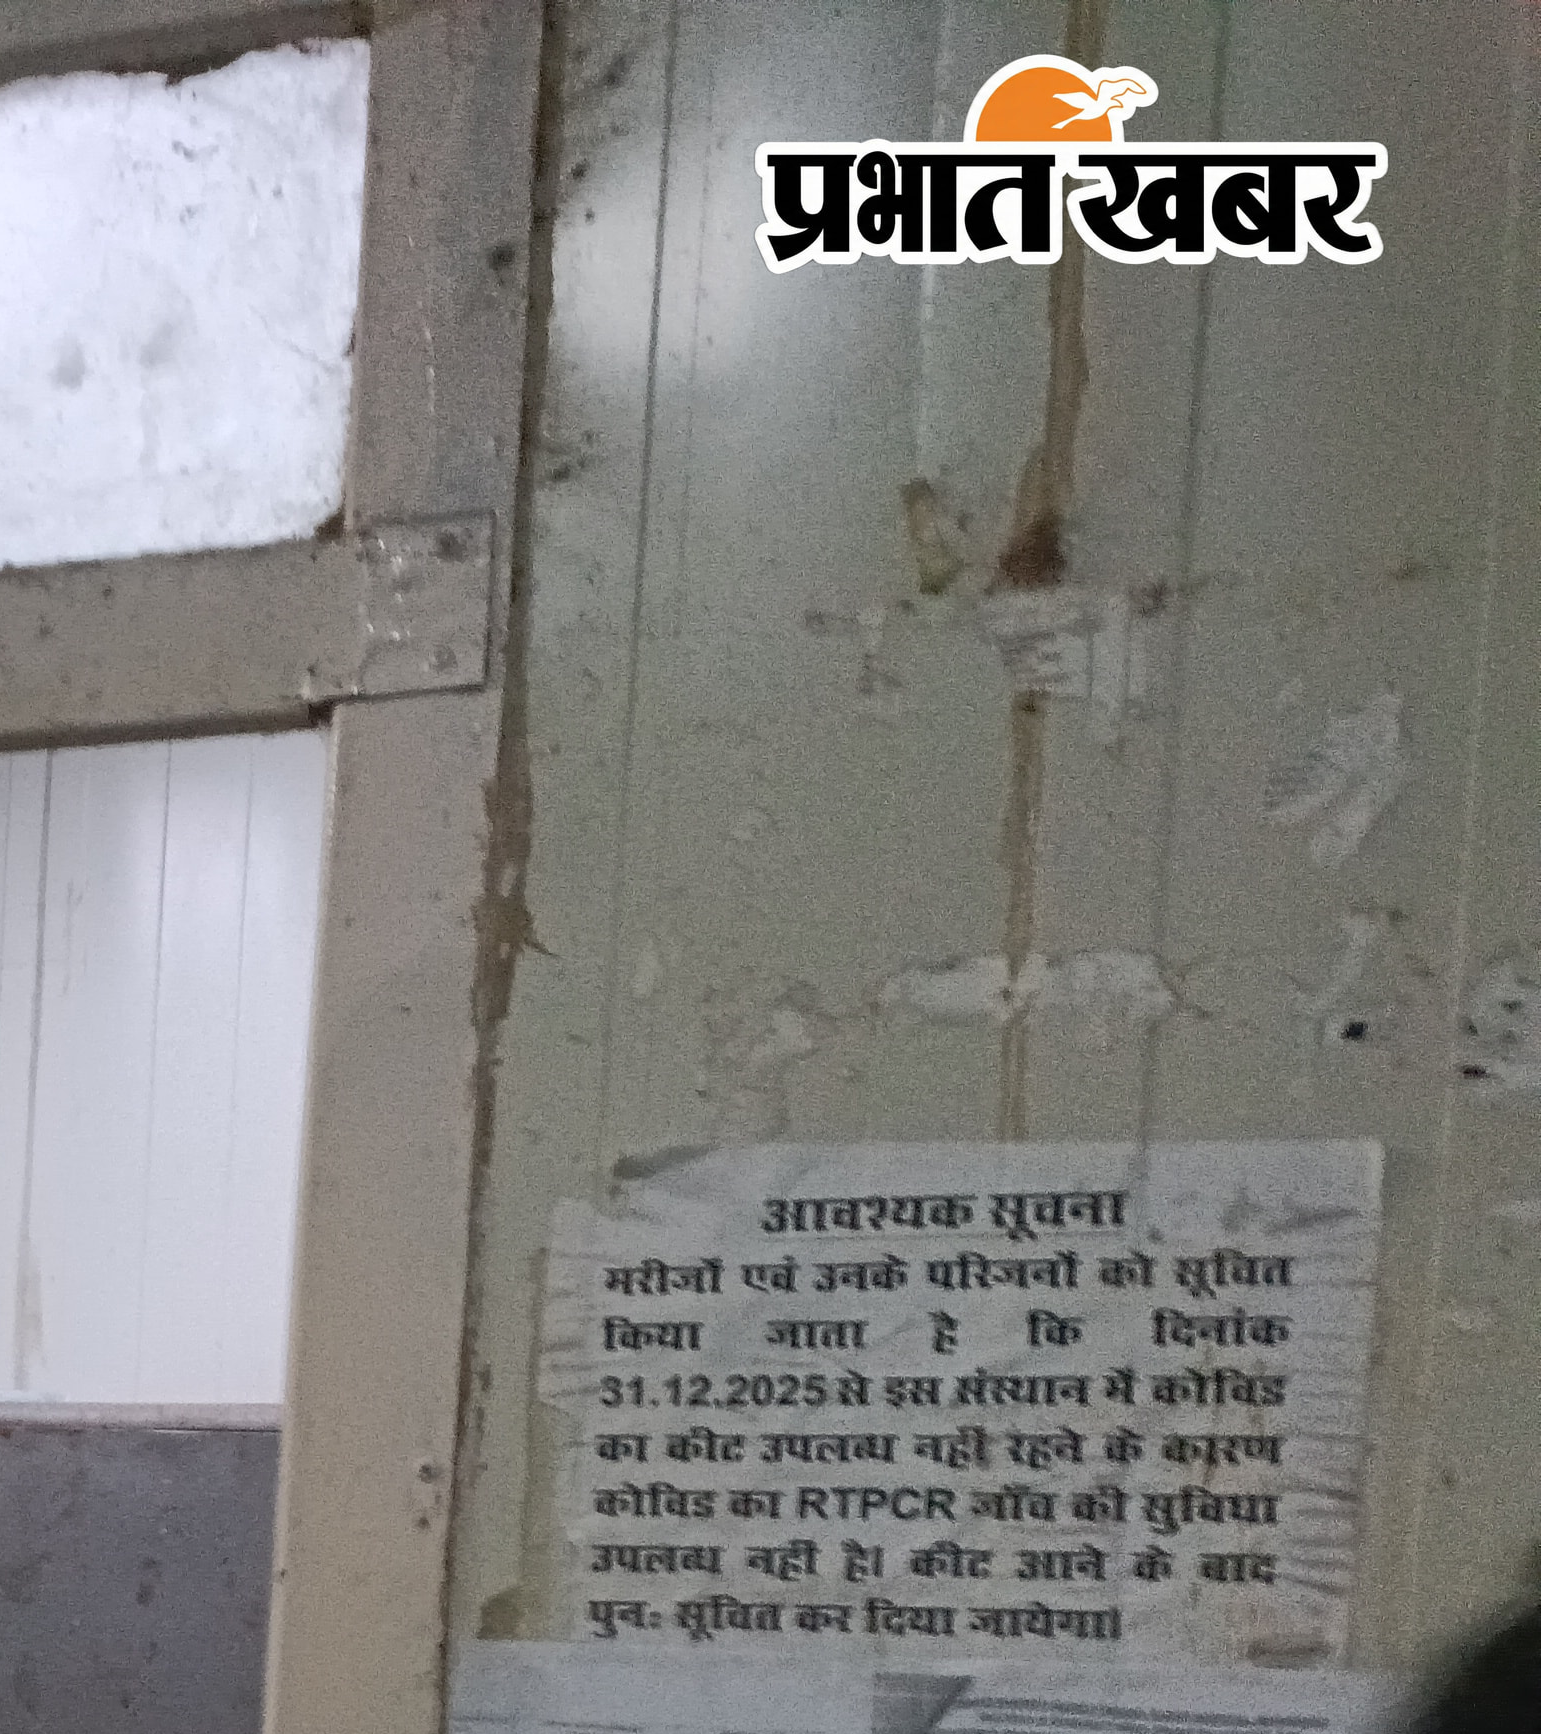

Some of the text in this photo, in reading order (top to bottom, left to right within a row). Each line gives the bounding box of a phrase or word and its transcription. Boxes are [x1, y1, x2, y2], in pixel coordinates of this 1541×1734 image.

[761, 1190, 1131, 1242] आवश्यक सूचना
[603, 1248, 1295, 1300] मरीजों एवं उनके परिजनों को सूचित
[603, 1307, 1296, 1354] किया जाता है कि दिनांक
[599, 1364, 1289, 1409] 31.12.2025 से इस संस्थान में कोविड
[594, 1433, 653, 1465] का
[665, 1425, 746, 1464] कीट
[759, 1433, 900, 1465] उपलब्ध
[1006, 1426, 1086, 1470] रहने
[1103, 1425, 1145, 1465] के
[1161, 1433, 1287, 1466] कारण
[592, 1481, 719, 1519] कोविड
[728, 1489, 786, 1520] का
[797, 1486, 957, 1522] RTPCR
[1070, 1484, 1129, 1522] की
[1141, 1484, 1283, 1537] सुविधा
[590, 1544, 725, 1576] उपलब्ध
[910, 1539, 995, 1580] कीट
[1017, 1543, 1108, 1581] आने
[1131, 1543, 1174, 1582] के
[1197, 1551, 1278, 1585] बाद
[674, 1594, 783, 1642] सूचित
[794, 1603, 854, 1635] कर
[865, 1598, 959, 1637] दिया
